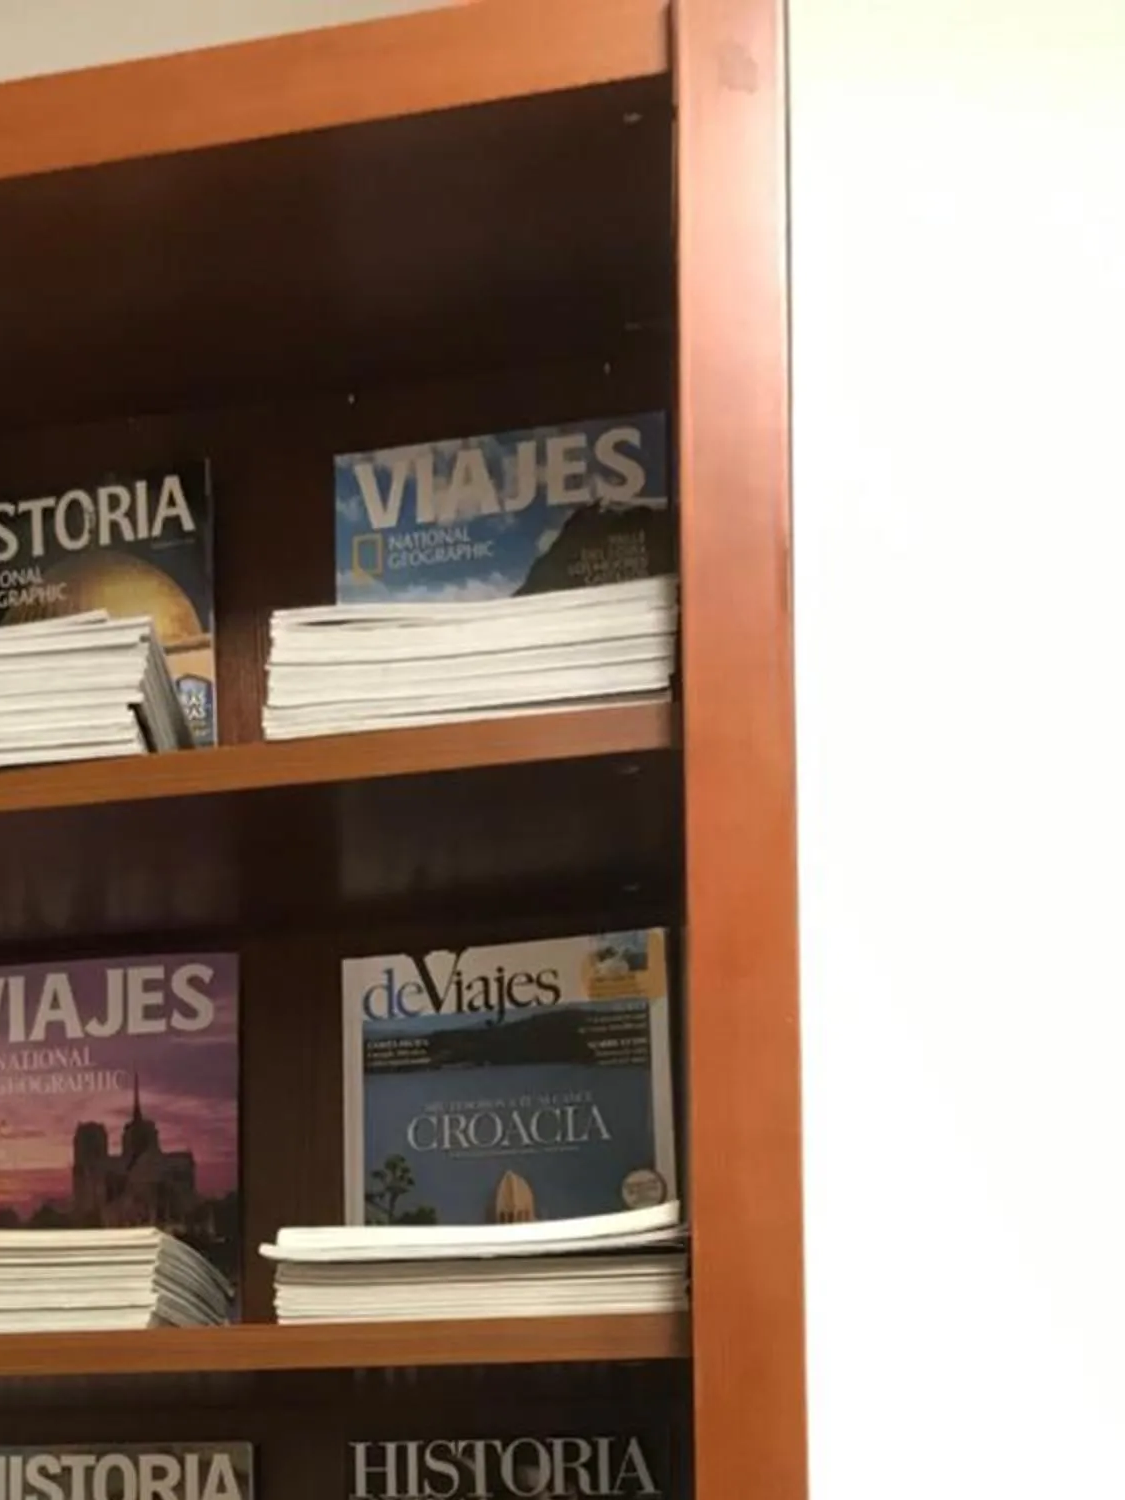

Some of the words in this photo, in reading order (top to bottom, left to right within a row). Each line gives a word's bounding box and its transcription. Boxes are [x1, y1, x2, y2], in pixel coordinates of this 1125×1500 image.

[353, 427, 646, 529] VIAJES
[387, 526, 471, 552] NATIONAL
[387, 541, 494, 570] GEOGRAPHIC
[406, 1103, 613, 1153] CROACIA
[348, 1435, 661, 1499] HISTORIA
